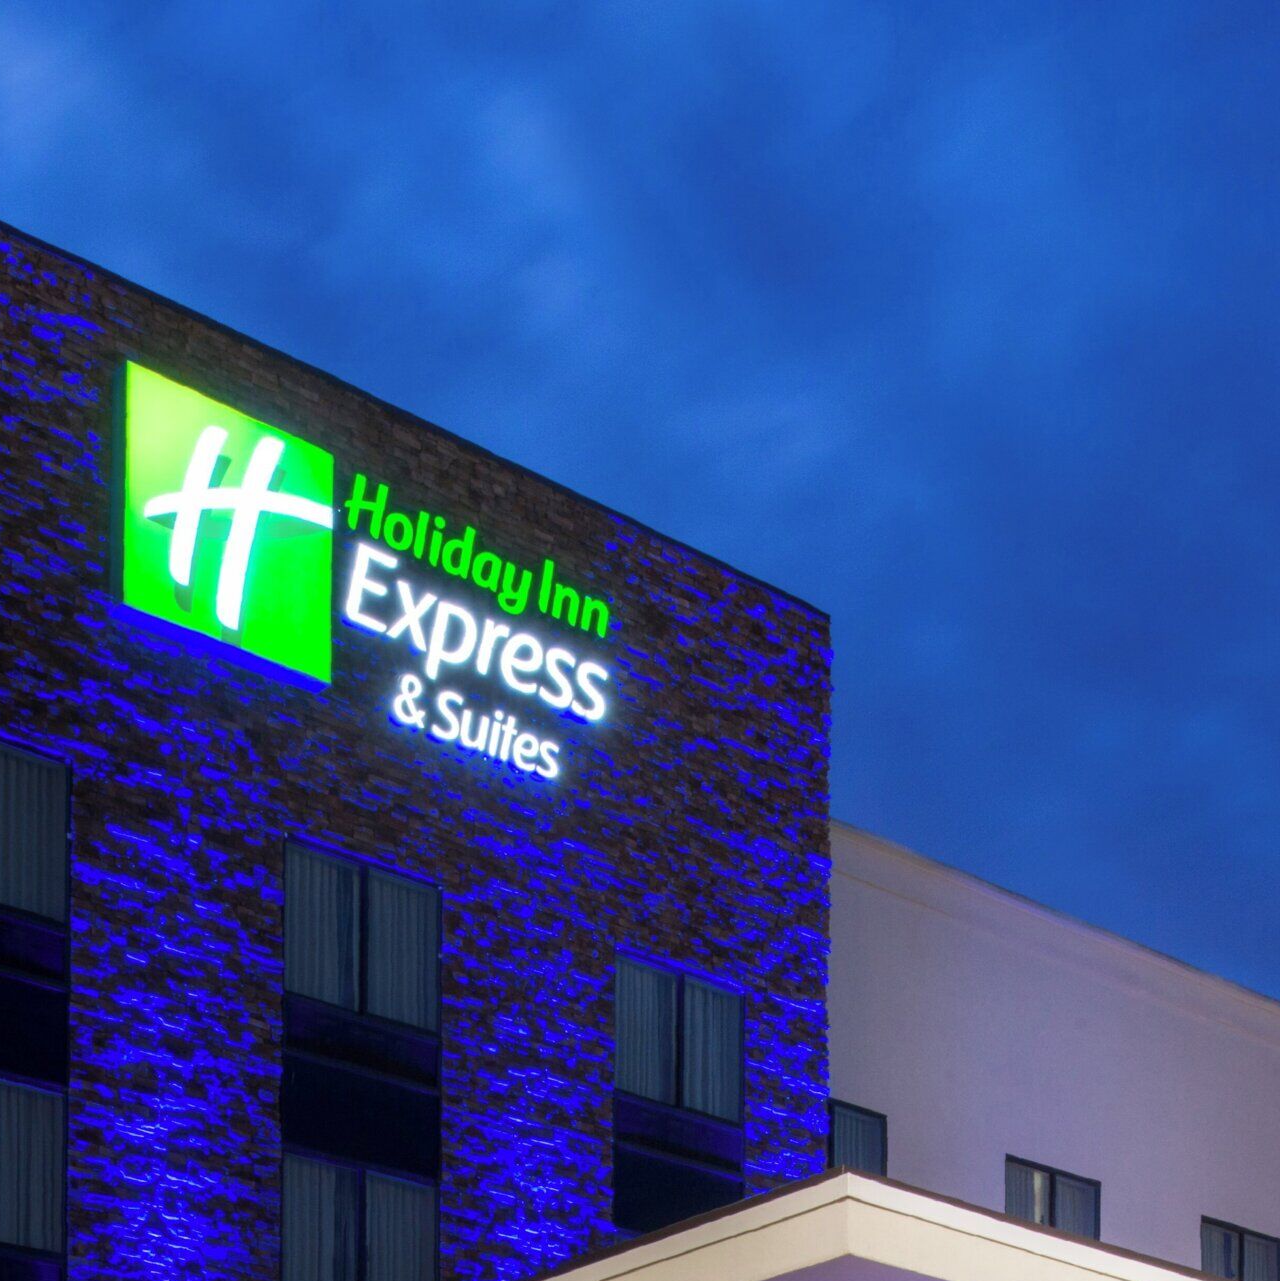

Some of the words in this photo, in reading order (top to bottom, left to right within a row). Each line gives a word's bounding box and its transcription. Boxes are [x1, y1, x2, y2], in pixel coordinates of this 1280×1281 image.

[345, 474, 532, 614] Holiday
[543, 560, 610, 638] Inn
[345, 543, 608, 721] Express
[394, 674, 425, 730] &
[432, 690, 560, 778] Suites
